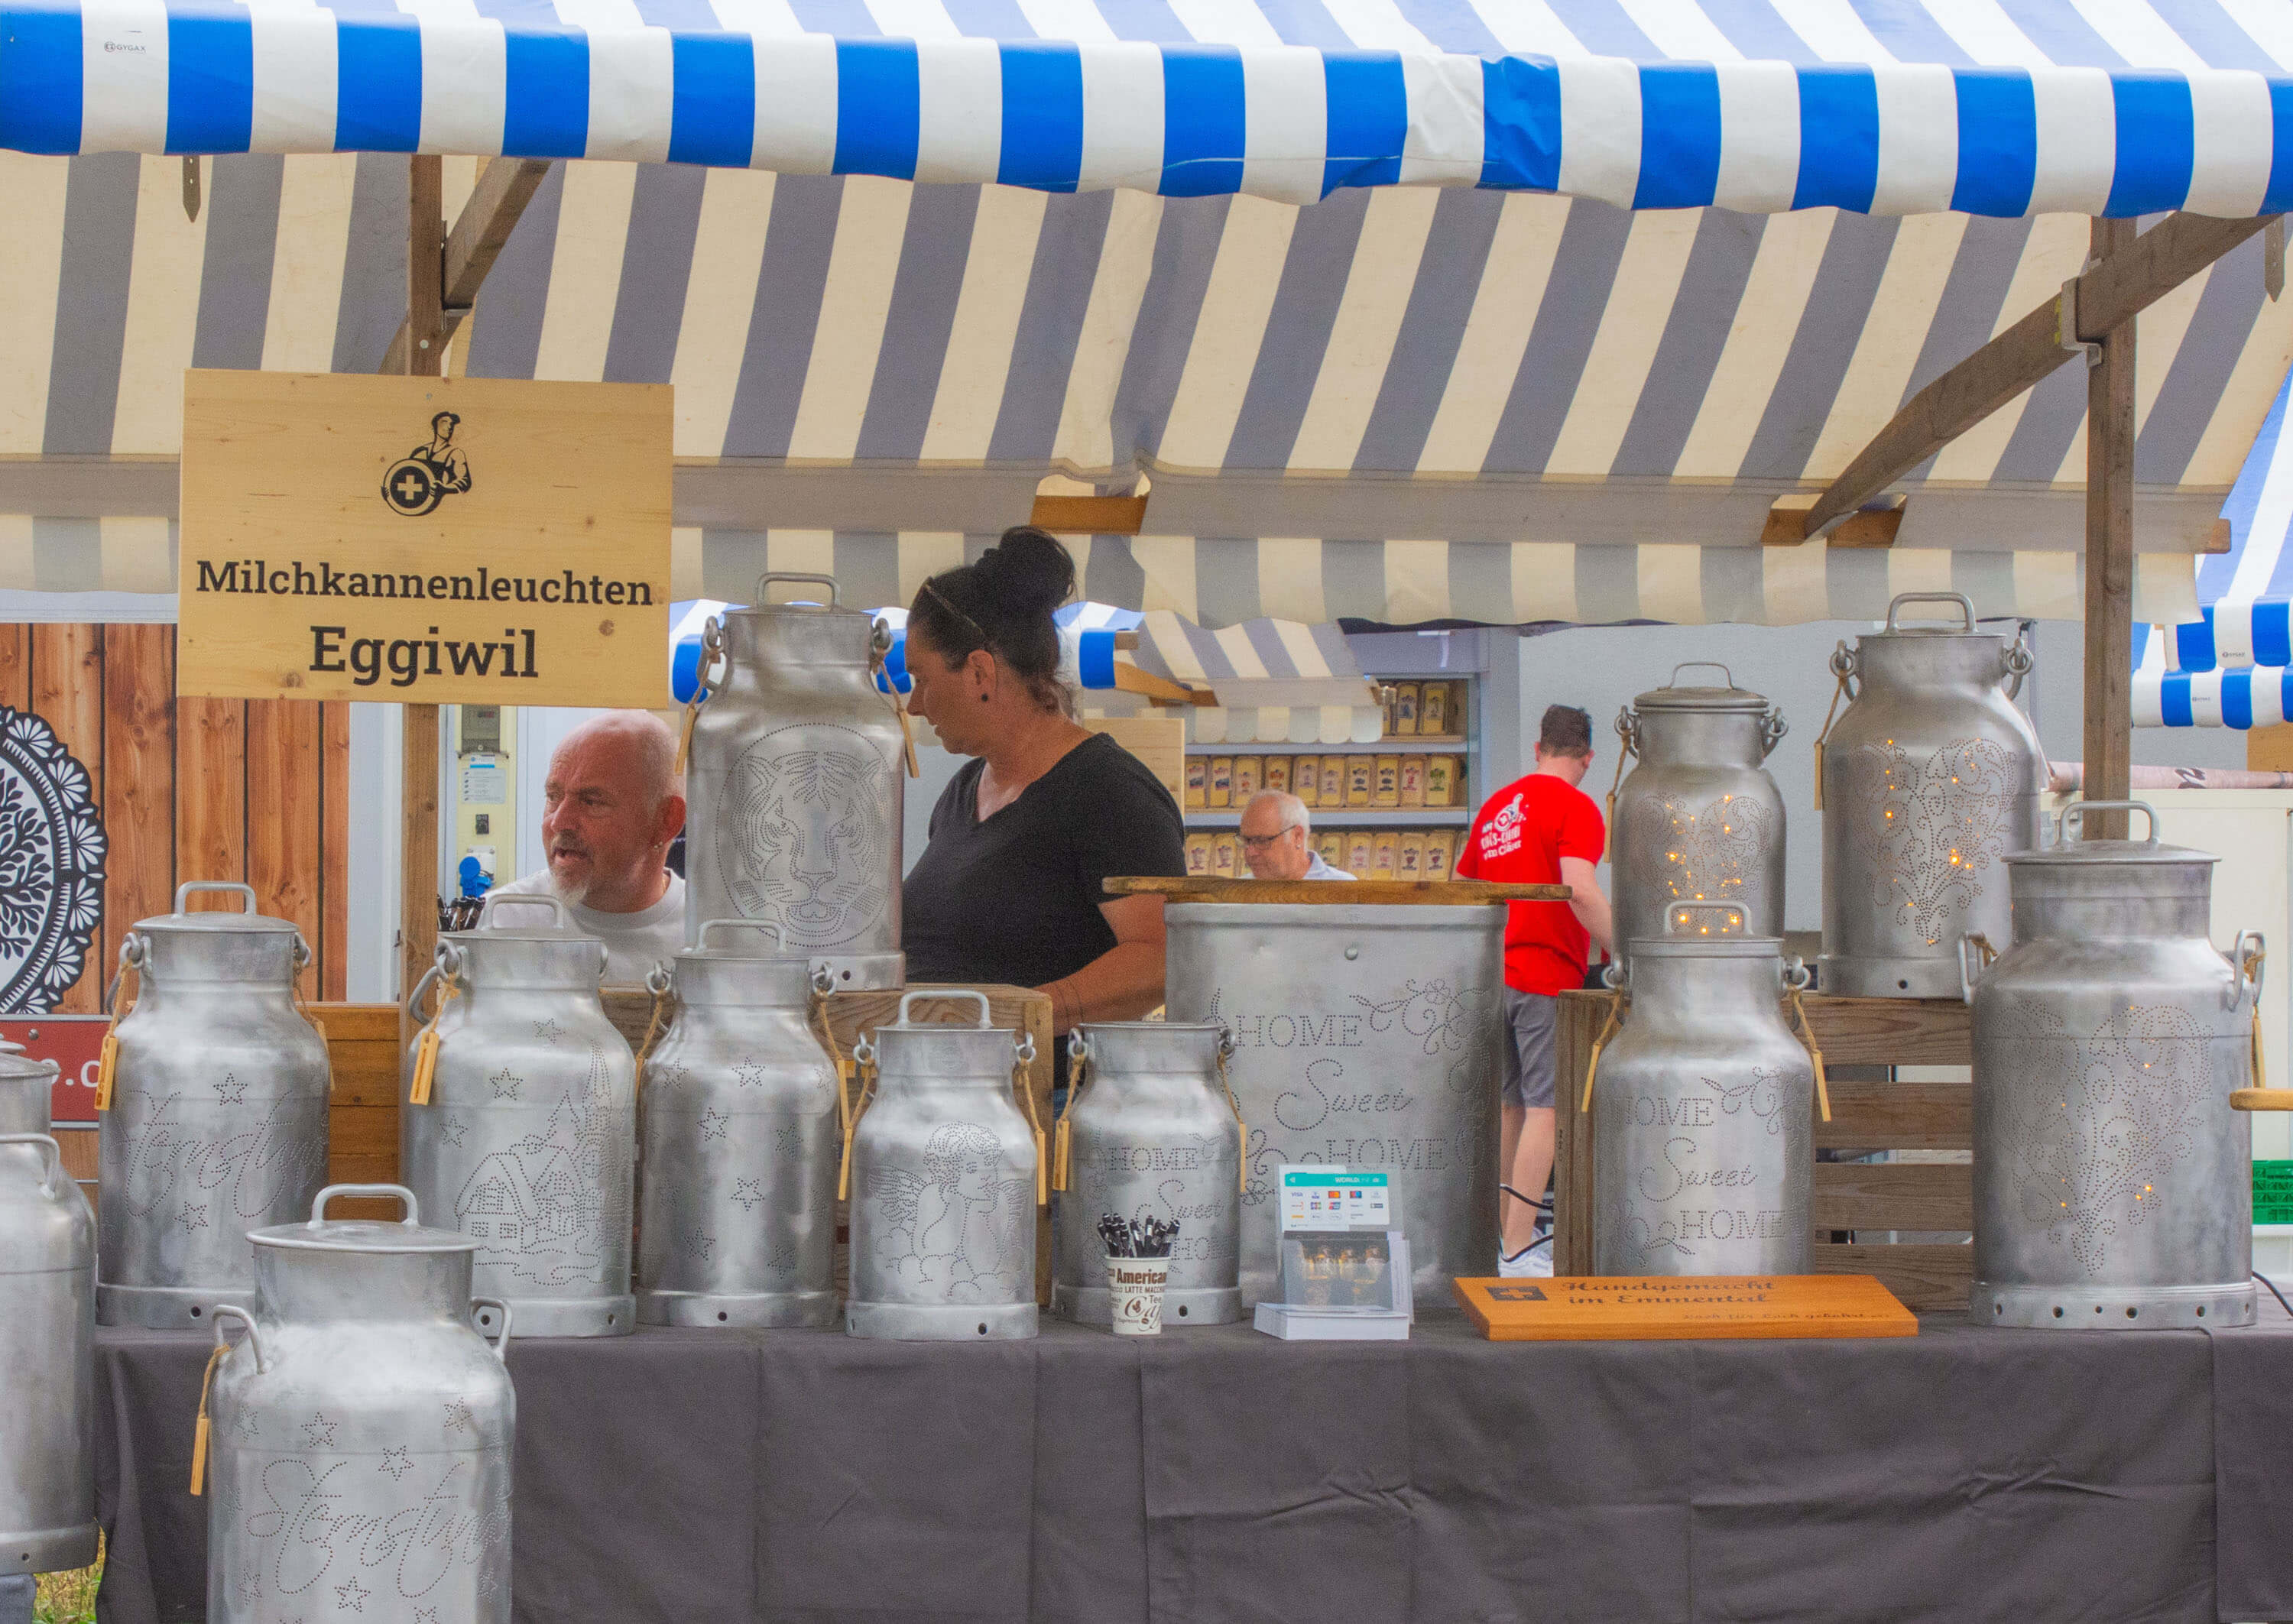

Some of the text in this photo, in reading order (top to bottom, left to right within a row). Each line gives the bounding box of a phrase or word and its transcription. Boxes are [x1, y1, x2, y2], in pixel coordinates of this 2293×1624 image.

[115, 44, 146, 52] GYGAX
[196, 559, 654, 606] Milchkannenleuchten
[309, 625, 540, 687] Eggiwil
[1235, 1014, 1363, 1047] HOME
[1274, 1058, 1413, 1131] Sweet
[1108, 1147, 1199, 1172] HOME
[1325, 1137, 1448, 1171] HOME
[1639, 1136, 1758, 1203] Sweet
[1680, 1210, 1786, 1240] HOME
[1561, 1280, 1774, 1292] Handgemacht
[1568, 1294, 1767, 1304] im Emmental
